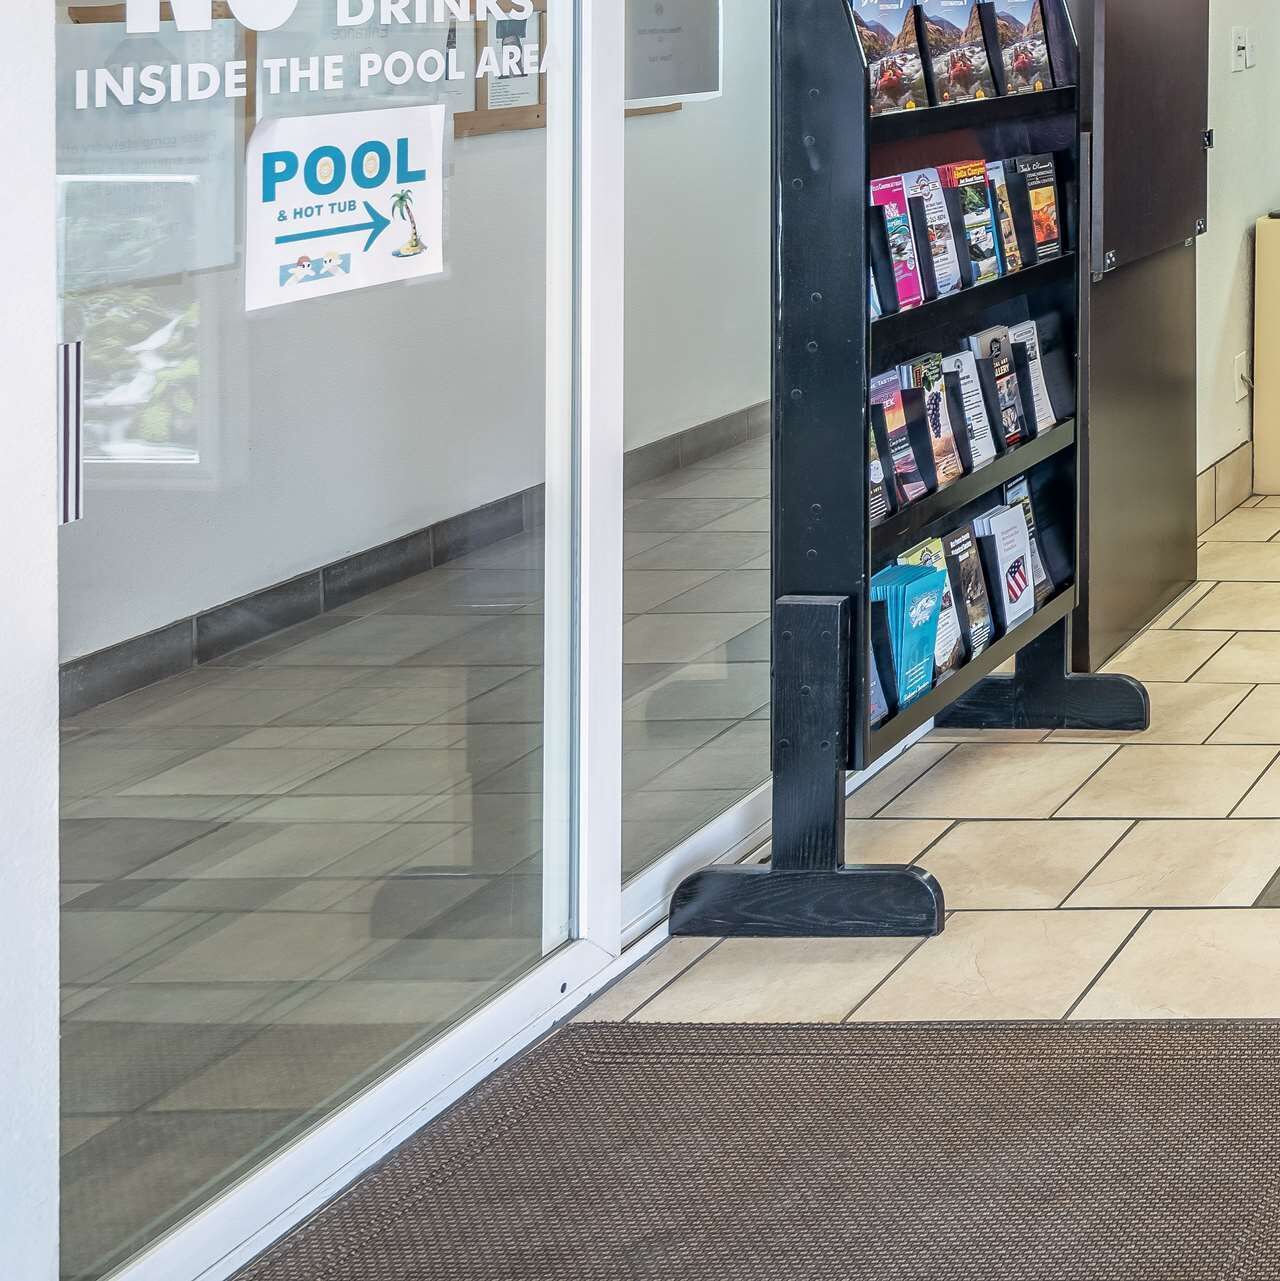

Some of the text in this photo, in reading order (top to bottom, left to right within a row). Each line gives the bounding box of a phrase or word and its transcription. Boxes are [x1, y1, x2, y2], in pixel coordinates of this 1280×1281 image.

[75, 42, 562, 110] INSIDE THE POOL AREA
[261, 137, 426, 202] POOL
[277, 200, 357, 222] & HOT TUB
